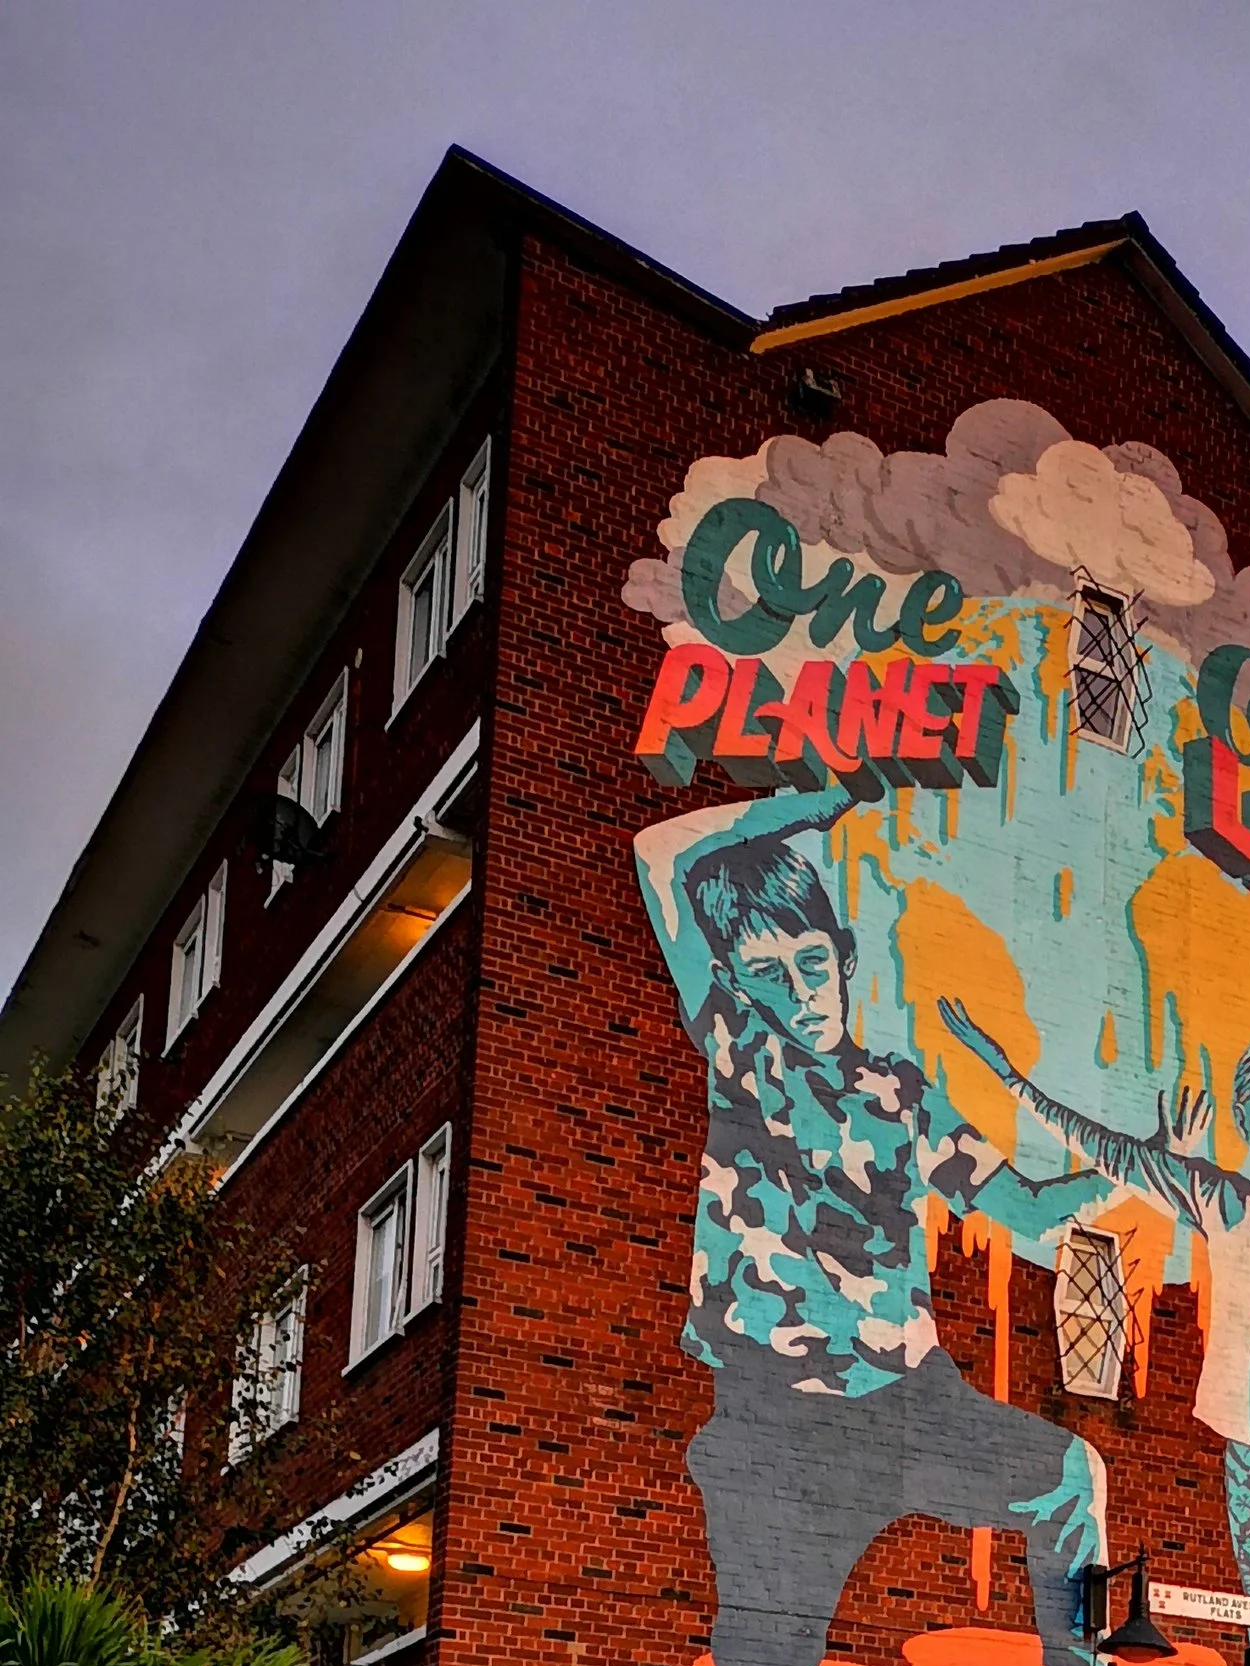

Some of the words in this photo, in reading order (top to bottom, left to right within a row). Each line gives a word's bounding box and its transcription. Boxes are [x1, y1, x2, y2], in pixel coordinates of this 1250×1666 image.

[681, 498, 964, 657] One
[635, 643, 1003, 775] PLANET
[1182, 1591, 1229, 1607] RUTLAND
[1210, 1607, 1242, 1620] FLATS
